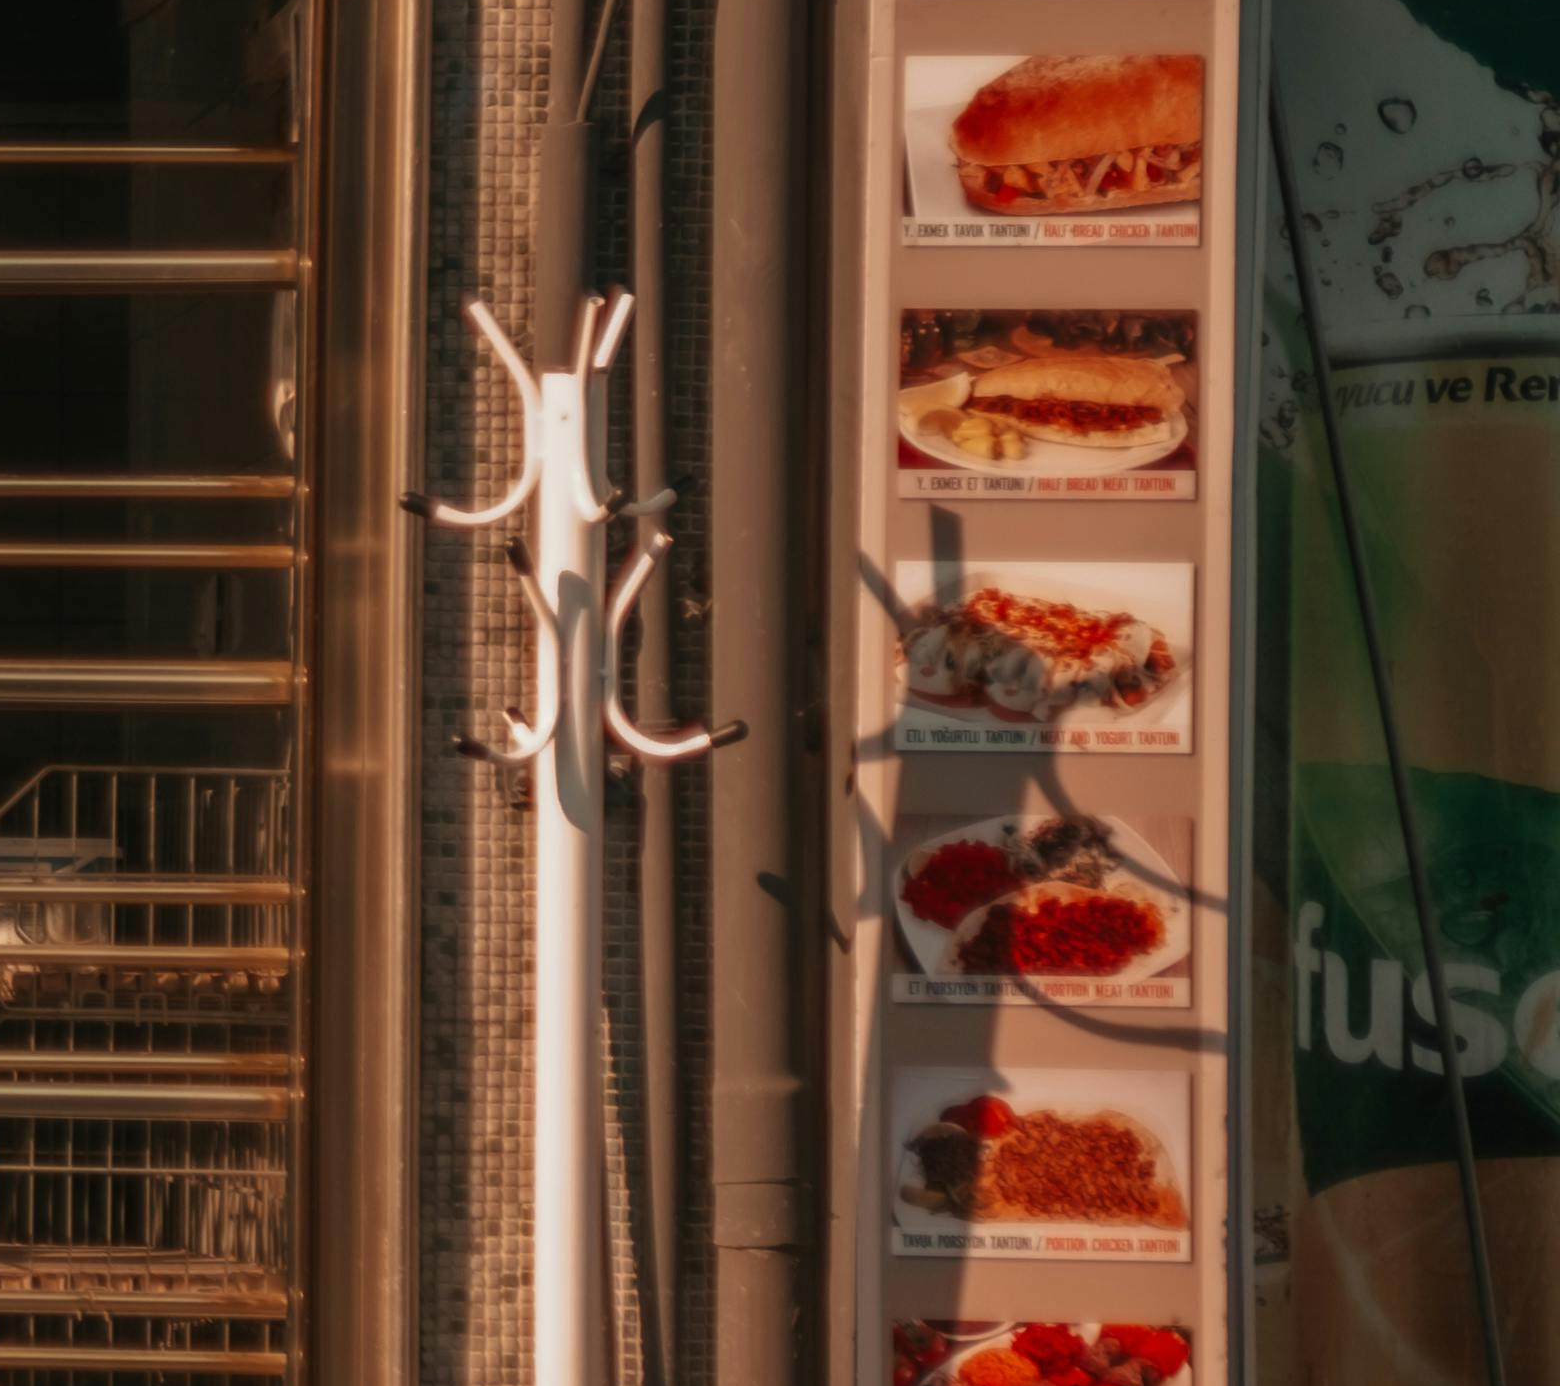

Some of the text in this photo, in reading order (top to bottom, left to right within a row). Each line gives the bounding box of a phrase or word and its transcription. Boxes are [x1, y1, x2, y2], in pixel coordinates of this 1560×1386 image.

[917, 224, 949, 238] EKMEK
[953, 224, 984, 238] TAVUK
[1108, 224, 1150, 238] CHICKEN
[1425, 377, 1474, 405] ve
[930, 477, 963, 491] EKMEK
[967, 477, 978, 491] ET
[1037, 477, 1062, 491] HALF
[1066, 477, 1097, 491] BREAD
[1102, 477, 1128, 491] MEAT
[1039, 730, 1065, 745] MEAT
[1095, 984, 1122, 998] MEAT
[1045, 1238, 1088, 1252] PORTION
[1092, 1239, 1133, 1253] CHICKEN
